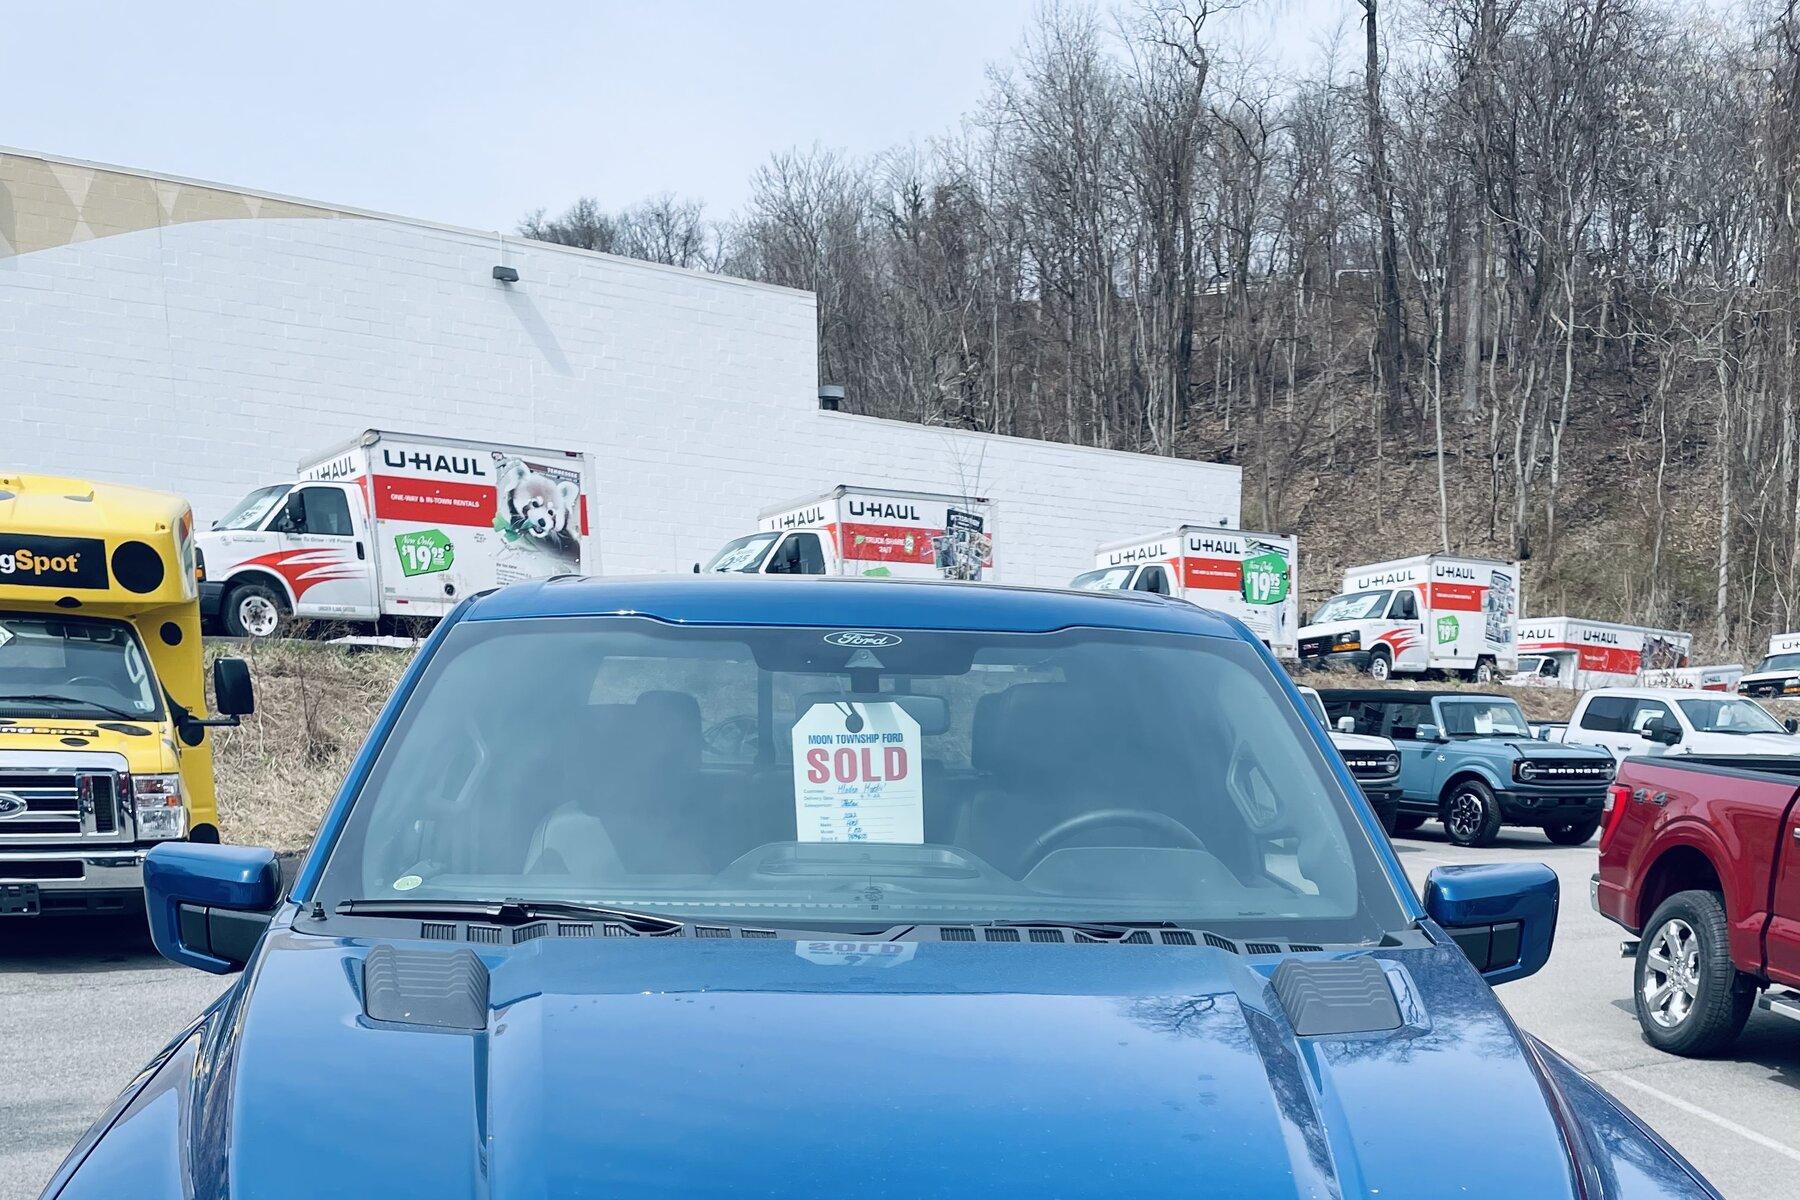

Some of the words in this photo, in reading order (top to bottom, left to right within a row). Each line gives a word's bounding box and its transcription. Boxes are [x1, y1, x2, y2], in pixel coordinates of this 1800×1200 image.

[383, 449, 486, 476] U-HAUL
[849, 500, 920, 521] U-HAUL
[1110, 544, 1168, 566] U-HAUL
[1190, 538, 1241, 555] U-HAUL
[1359, 570, 1416, 589] U-HAUL
[1436, 566, 1475, 580] U-HAUL
[837, 632, 888, 645] Ford
[1583, 630, 1618, 644] U-HAUL
[808, 734, 833, 744] MOON
[836, 733, 880, 744] TOWNSHIP
[882, 732, 904, 743] FORD
[807, 746, 908, 784] SOLD
